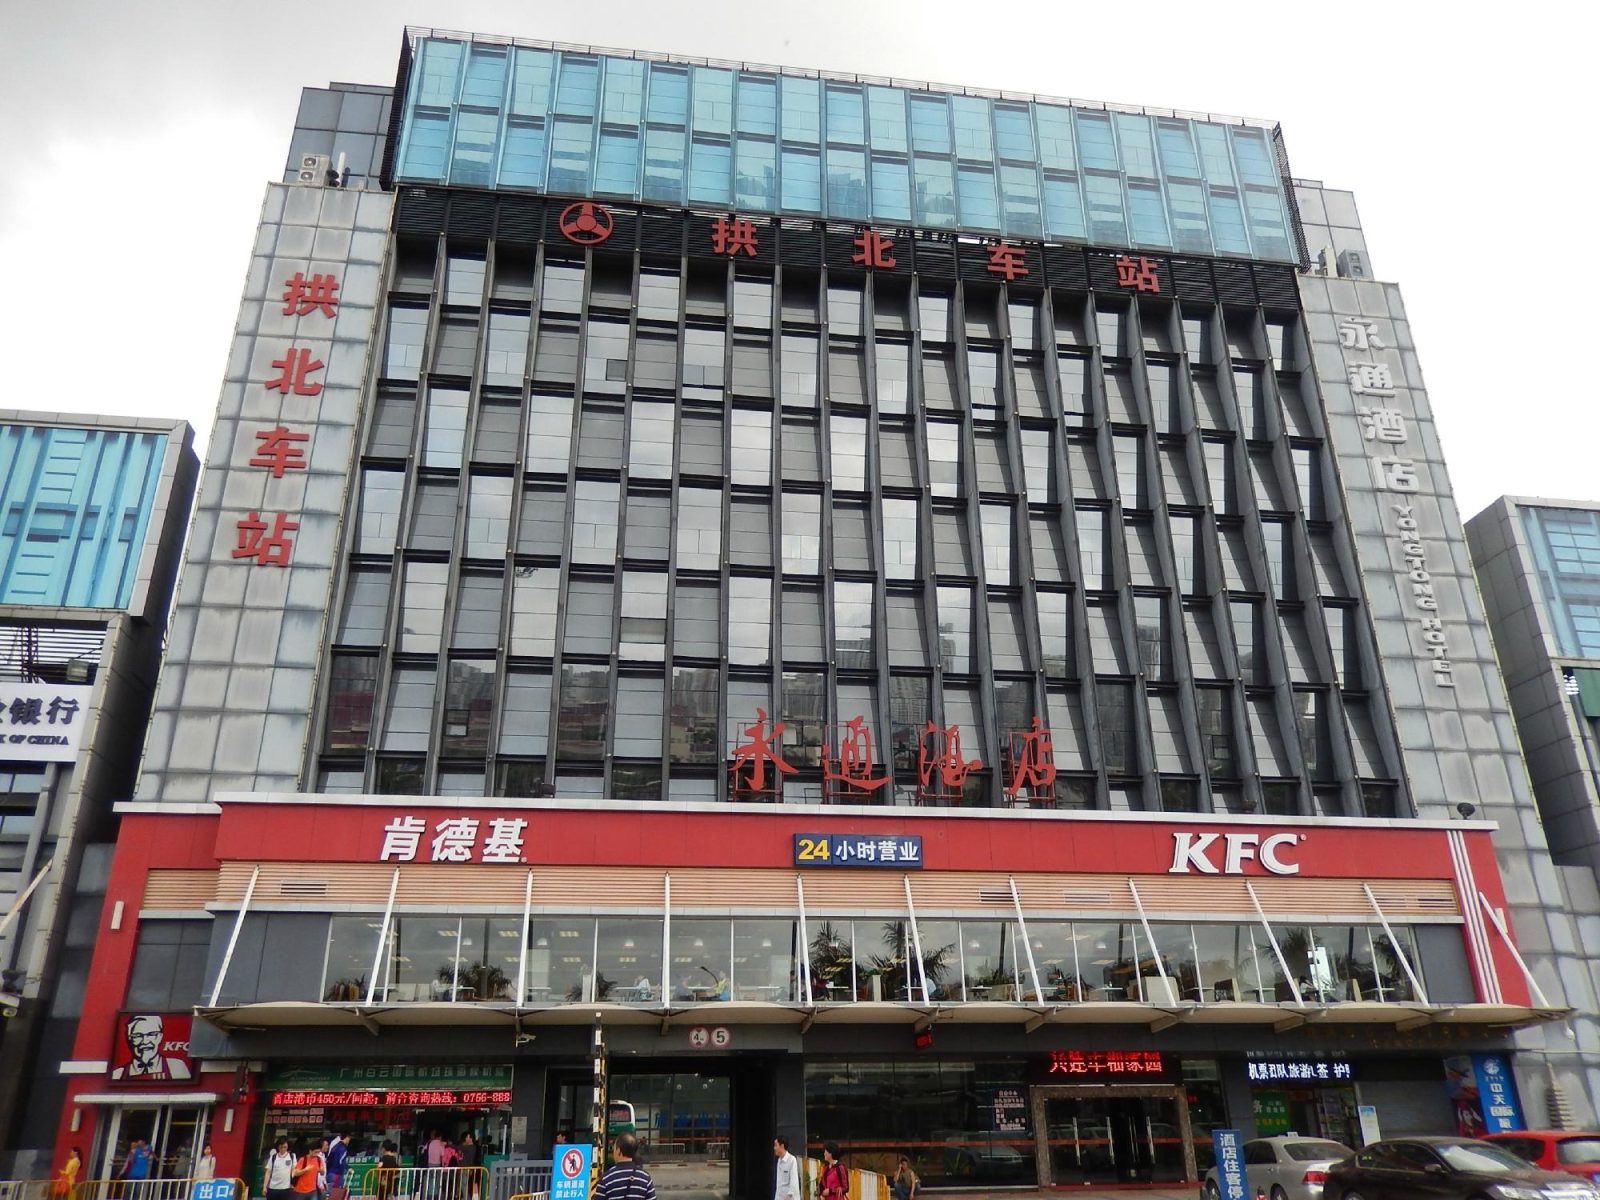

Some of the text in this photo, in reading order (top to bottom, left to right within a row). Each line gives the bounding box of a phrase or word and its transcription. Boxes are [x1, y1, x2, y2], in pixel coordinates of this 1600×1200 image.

[712, 218, 1161, 293] 拱北车站
[231, 272, 340, 567] 拱北车站
[1339, 318, 1420, 491] 永通酒店
[1391, 505, 1456, 688] YONGTONG HOTEL
[9, 735, 27, 744] OF
[27, 735, 69, 745] CHINA
[727, 707, 1057, 795] 永通酒店
[380, 815, 528, 863] 肯德基
[1168, 832, 1299, 875] KFC
[716, 1030, 726, 1043] 5
[1488, 1083, 1515, 1134] 中天国际旅
[199, 1183, 230, 1199] 出口
[1219, 1132, 1244, 1200] 酒店住客停
